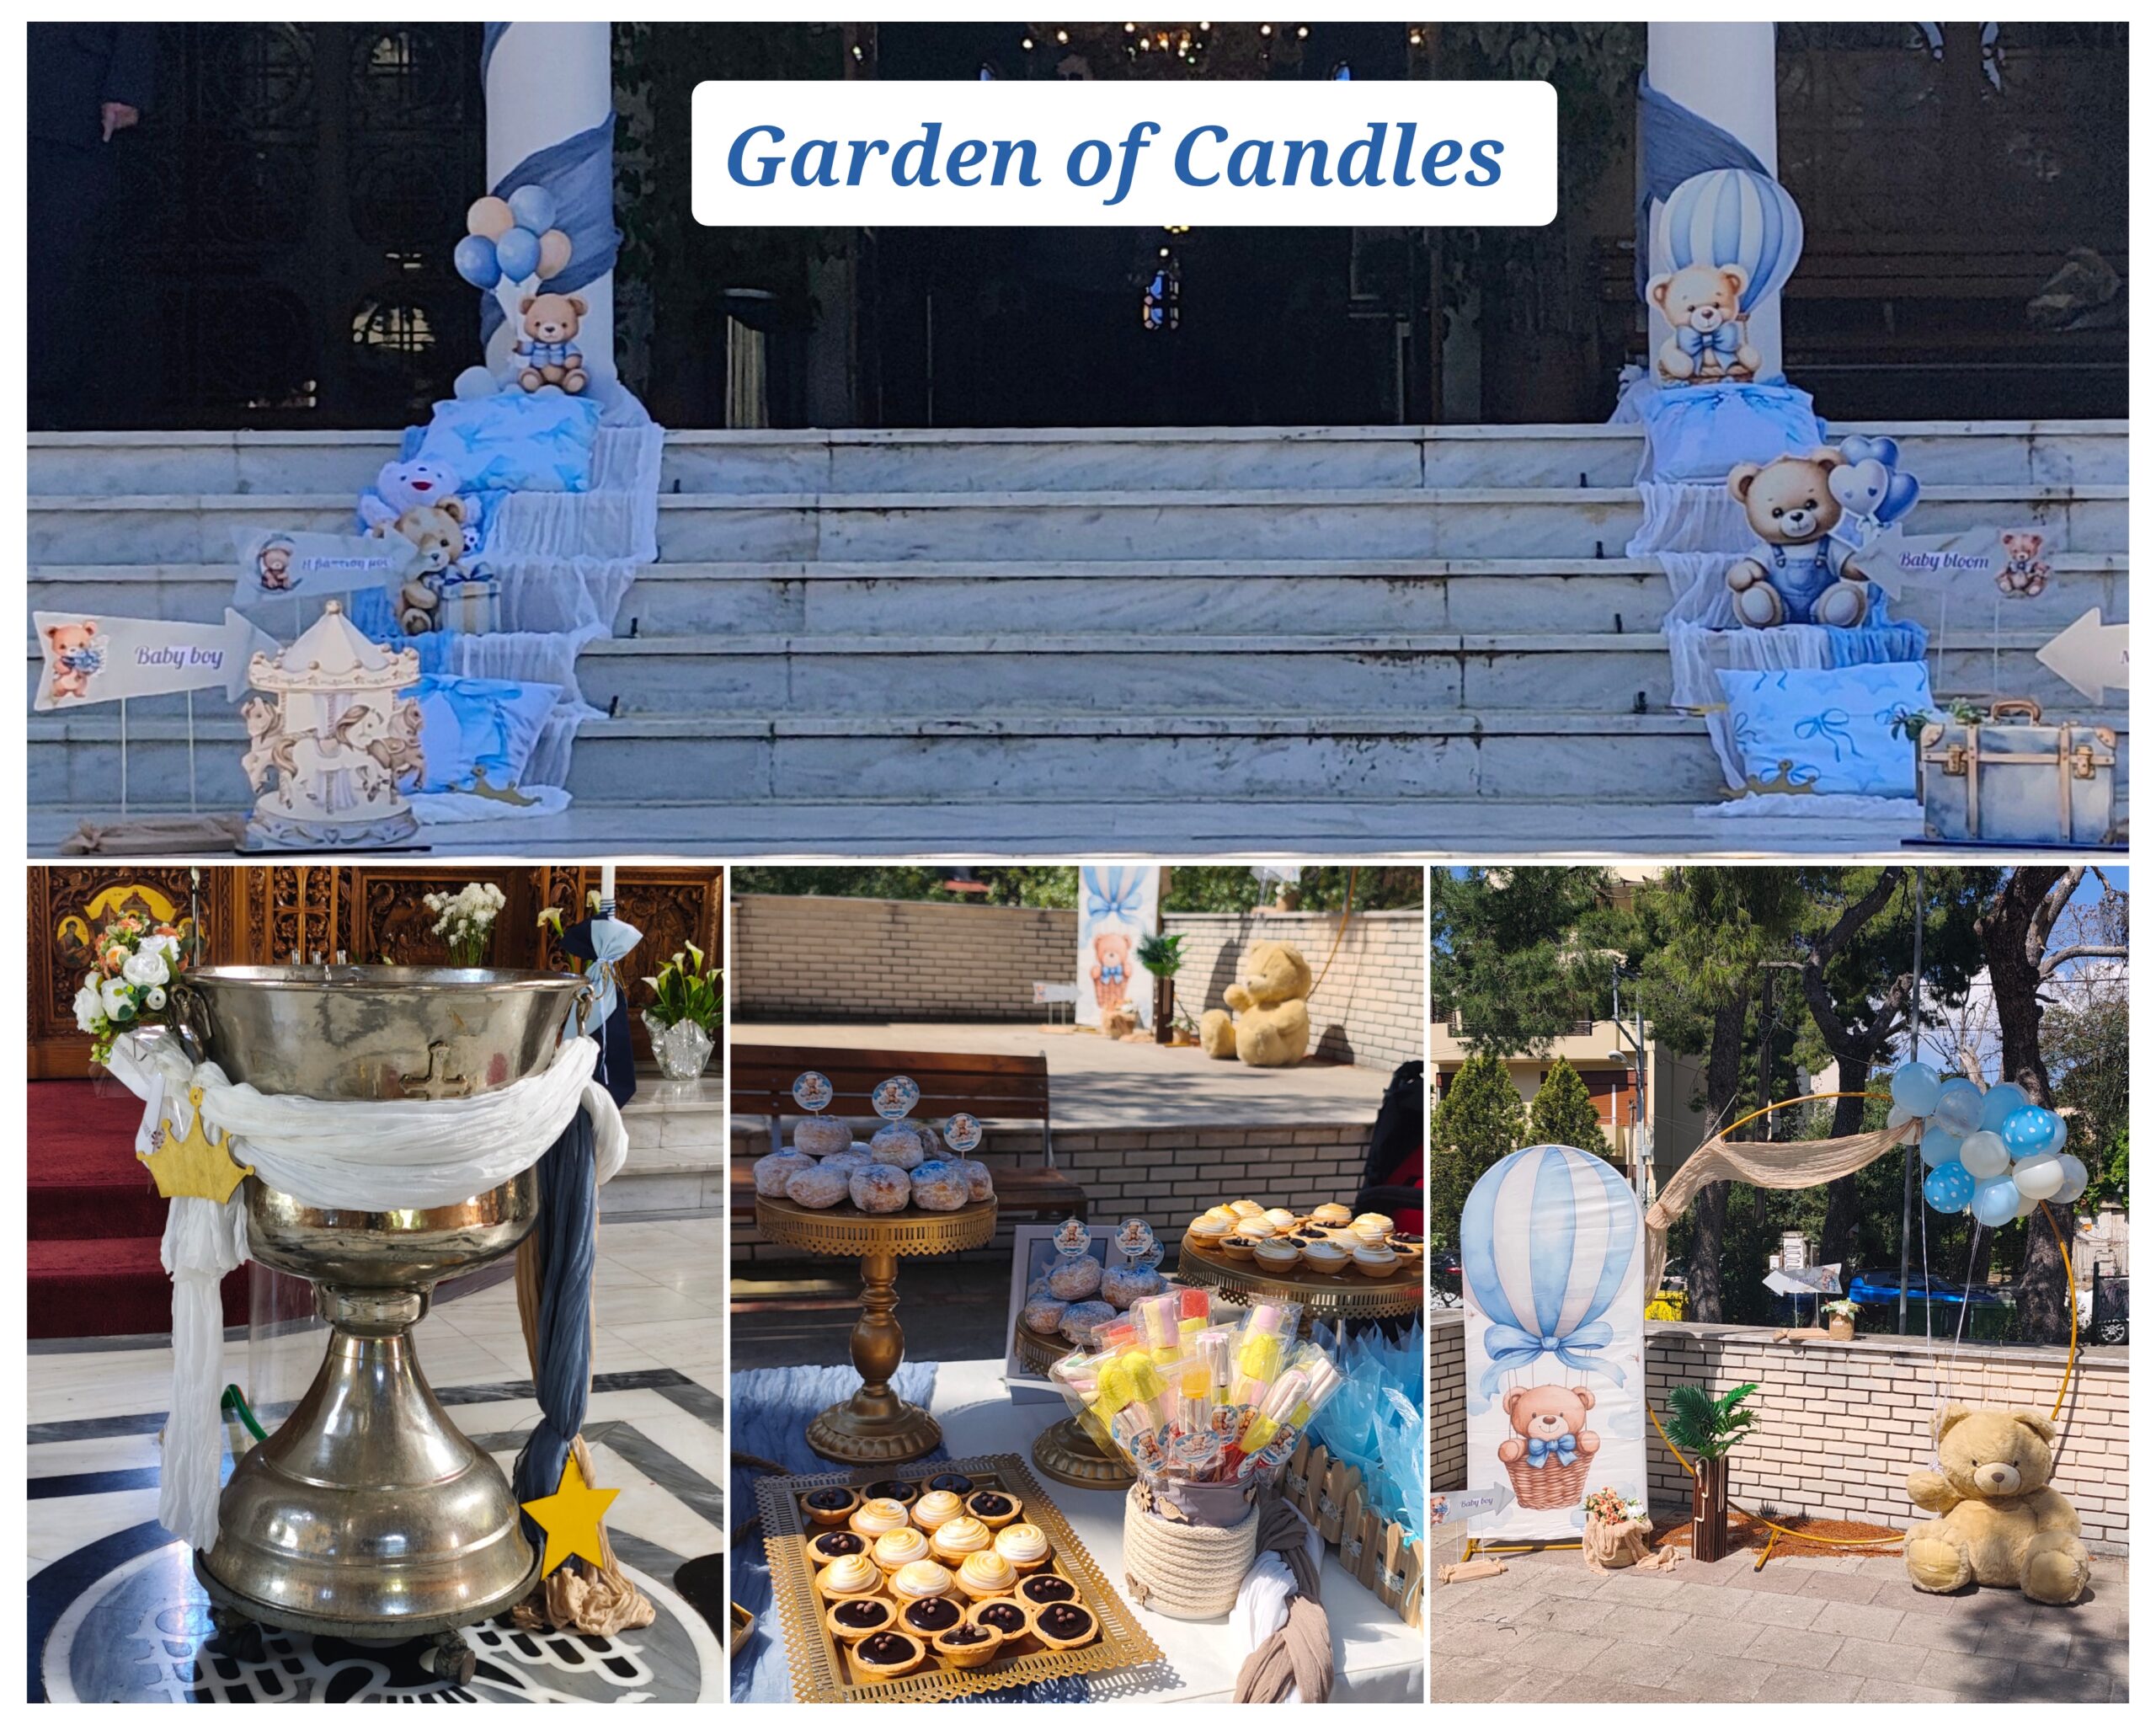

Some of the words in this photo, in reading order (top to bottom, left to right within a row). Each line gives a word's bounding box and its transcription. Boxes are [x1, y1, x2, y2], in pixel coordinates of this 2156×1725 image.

[1898, 551, 1940, 573] Baby
[1943, 553, 1989, 569] bloom
[134, 644, 186, 670] Baby
[189, 645, 224, 670] boy
[1461, 1499, 1480, 1508] Baby
[1480, 1497, 1494, 1506] boy
